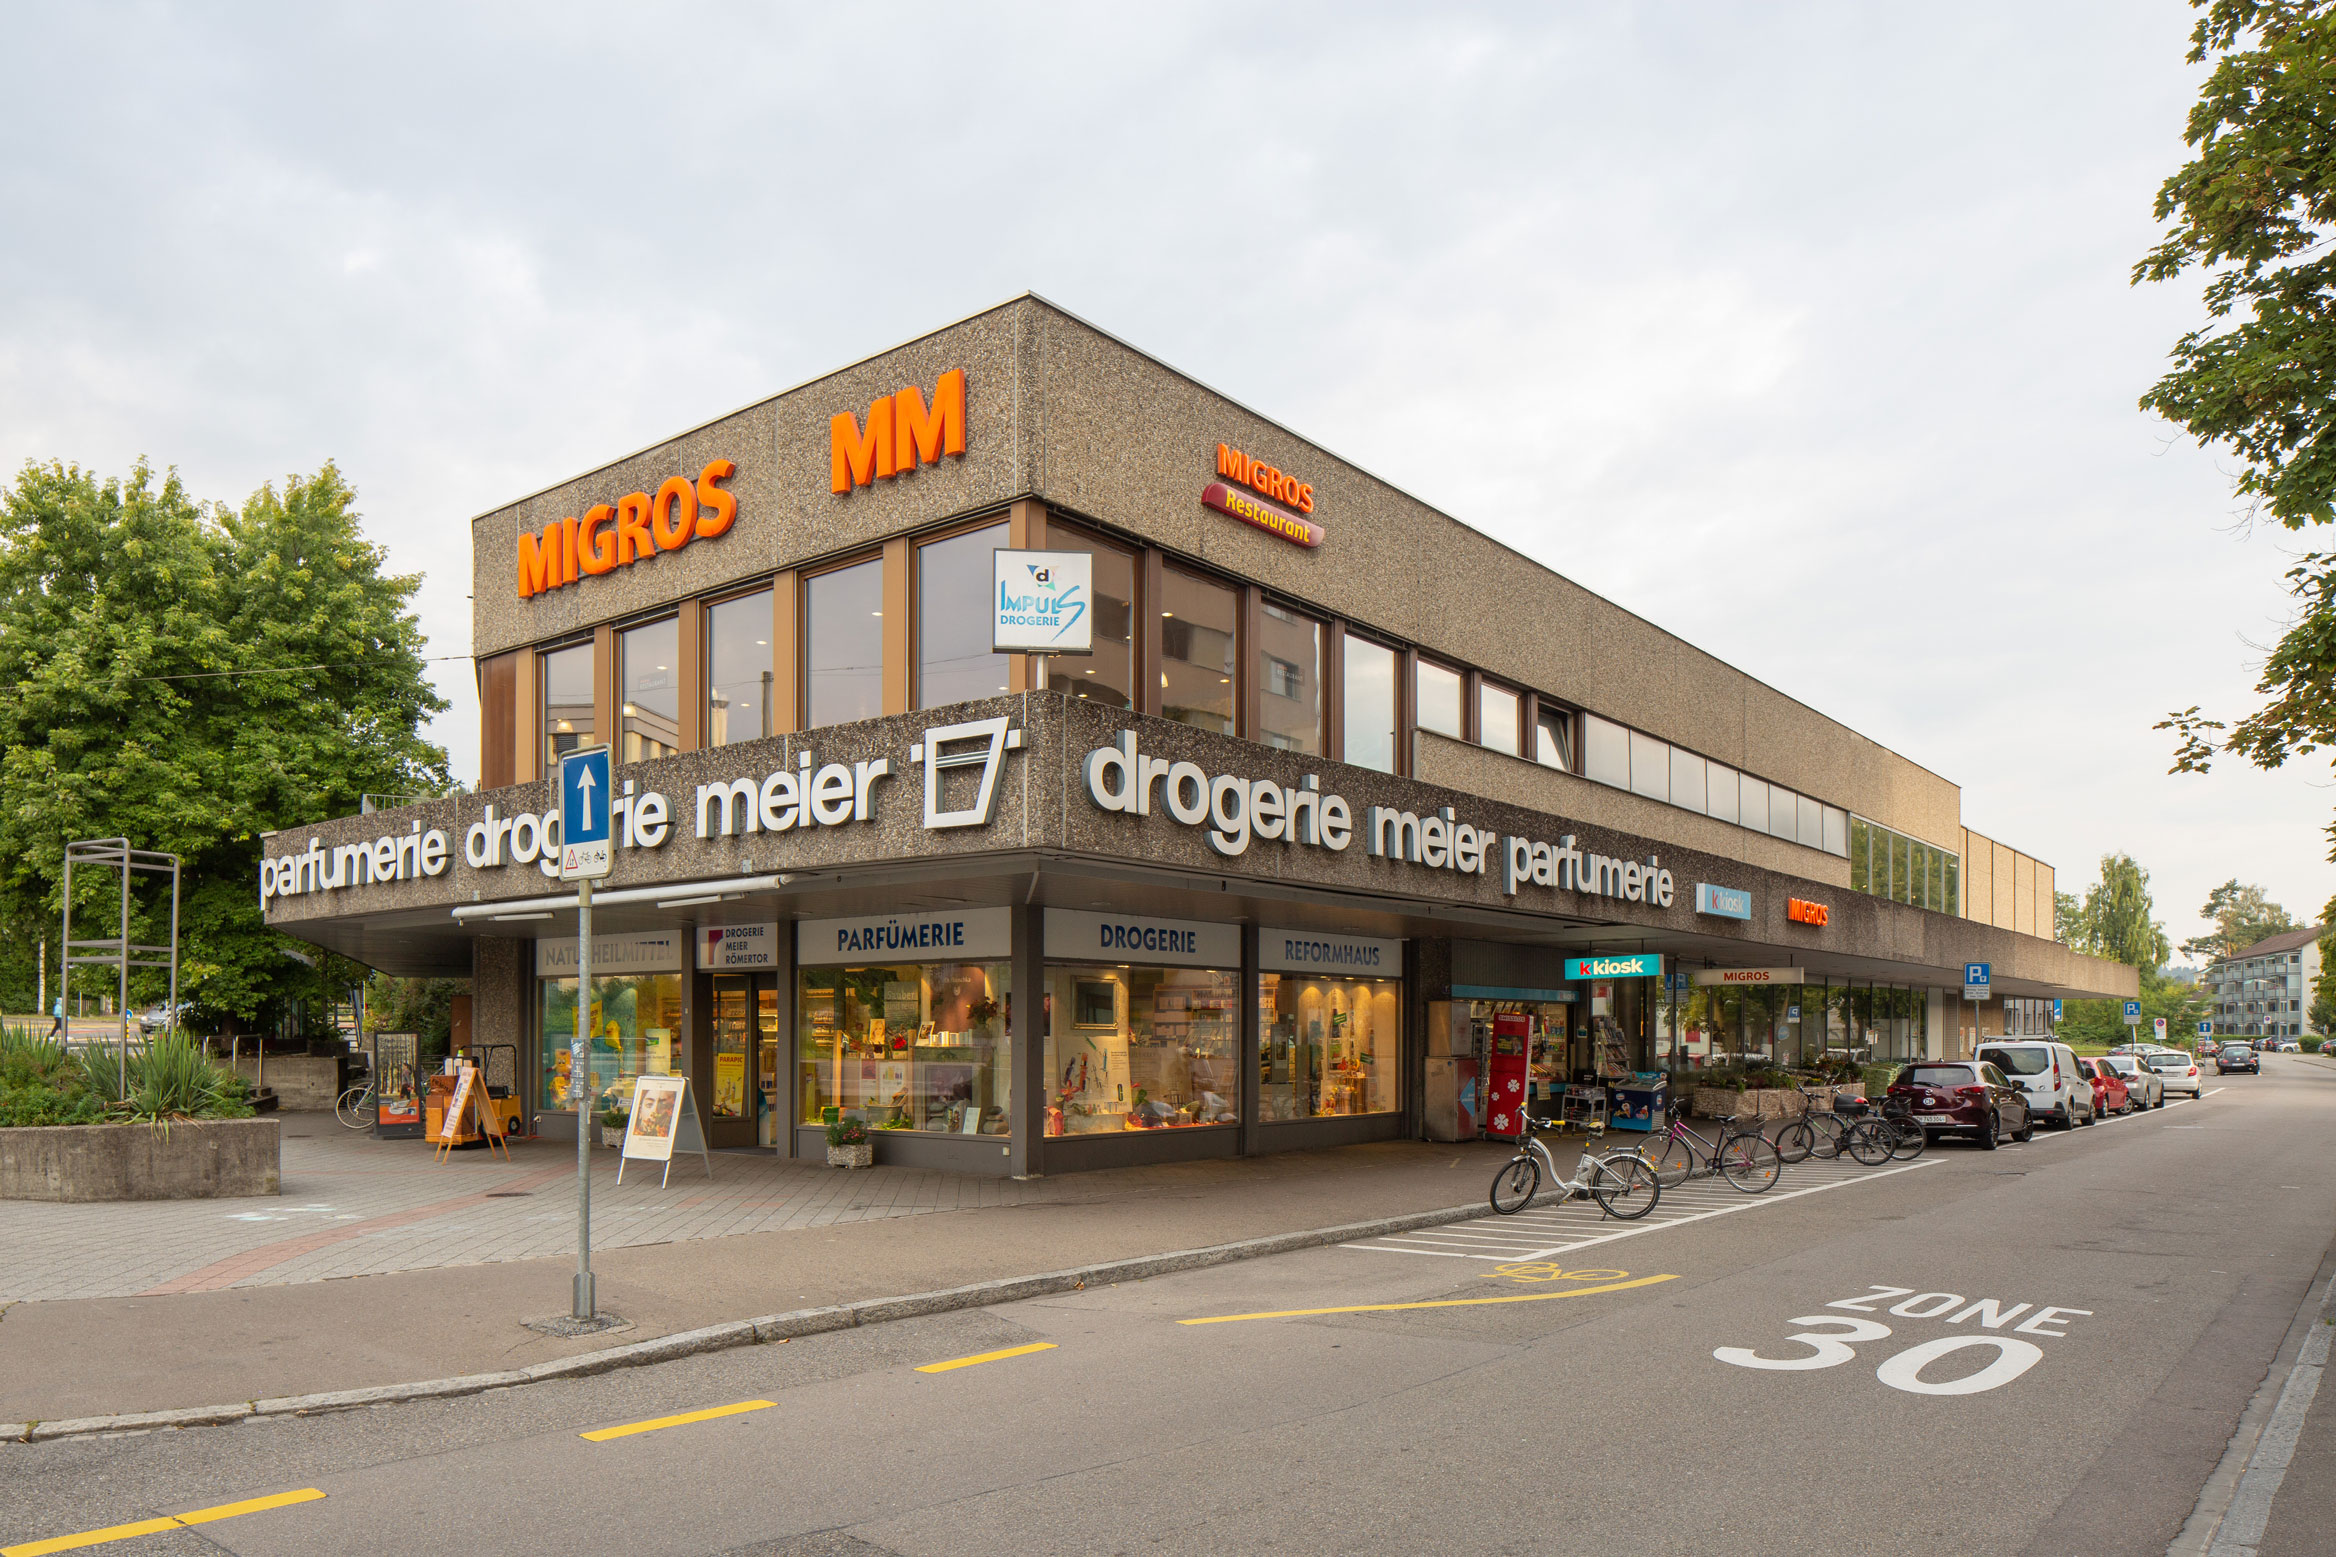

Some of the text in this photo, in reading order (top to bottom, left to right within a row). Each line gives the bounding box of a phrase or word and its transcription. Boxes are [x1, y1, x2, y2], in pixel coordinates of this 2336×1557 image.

[831, 368, 966, 495] MM
[1217, 443, 1315, 514] MIGROS
[518, 459, 738, 599] MIGROS
[1225, 488, 1311, 543] Restaurant
[1000, 615, 1060, 627] DROGERIE
[259, 819, 454, 911] parfumerie
[696, 750, 896, 839] meier
[1082, 729, 1675, 909] drogerie meier parfumerie
[1719, 890, 1745, 914] kiosk
[1787, 897, 1829, 926] MIGROS
[725, 926, 765, 938] DROGERIE
[725, 941, 749, 951] MEIER
[837, 920, 965, 952] PARFÜMERIE
[1100, 924, 1197, 954] DROGERIE
[545, 939, 673, 966] NATUHEILMITTEL
[725, 953, 769, 965] RÖMERTOR
[1285, 939, 1380, 966] REFORMHAUS
[1593, 958, 1644, 975] kiosk
[1723, 971, 1770, 982] MIGROS
[1969, 966, 1982, 983] P
[1824, 1285, 2094, 1338] ZONE
[1713, 1315, 2044, 1396] 30
